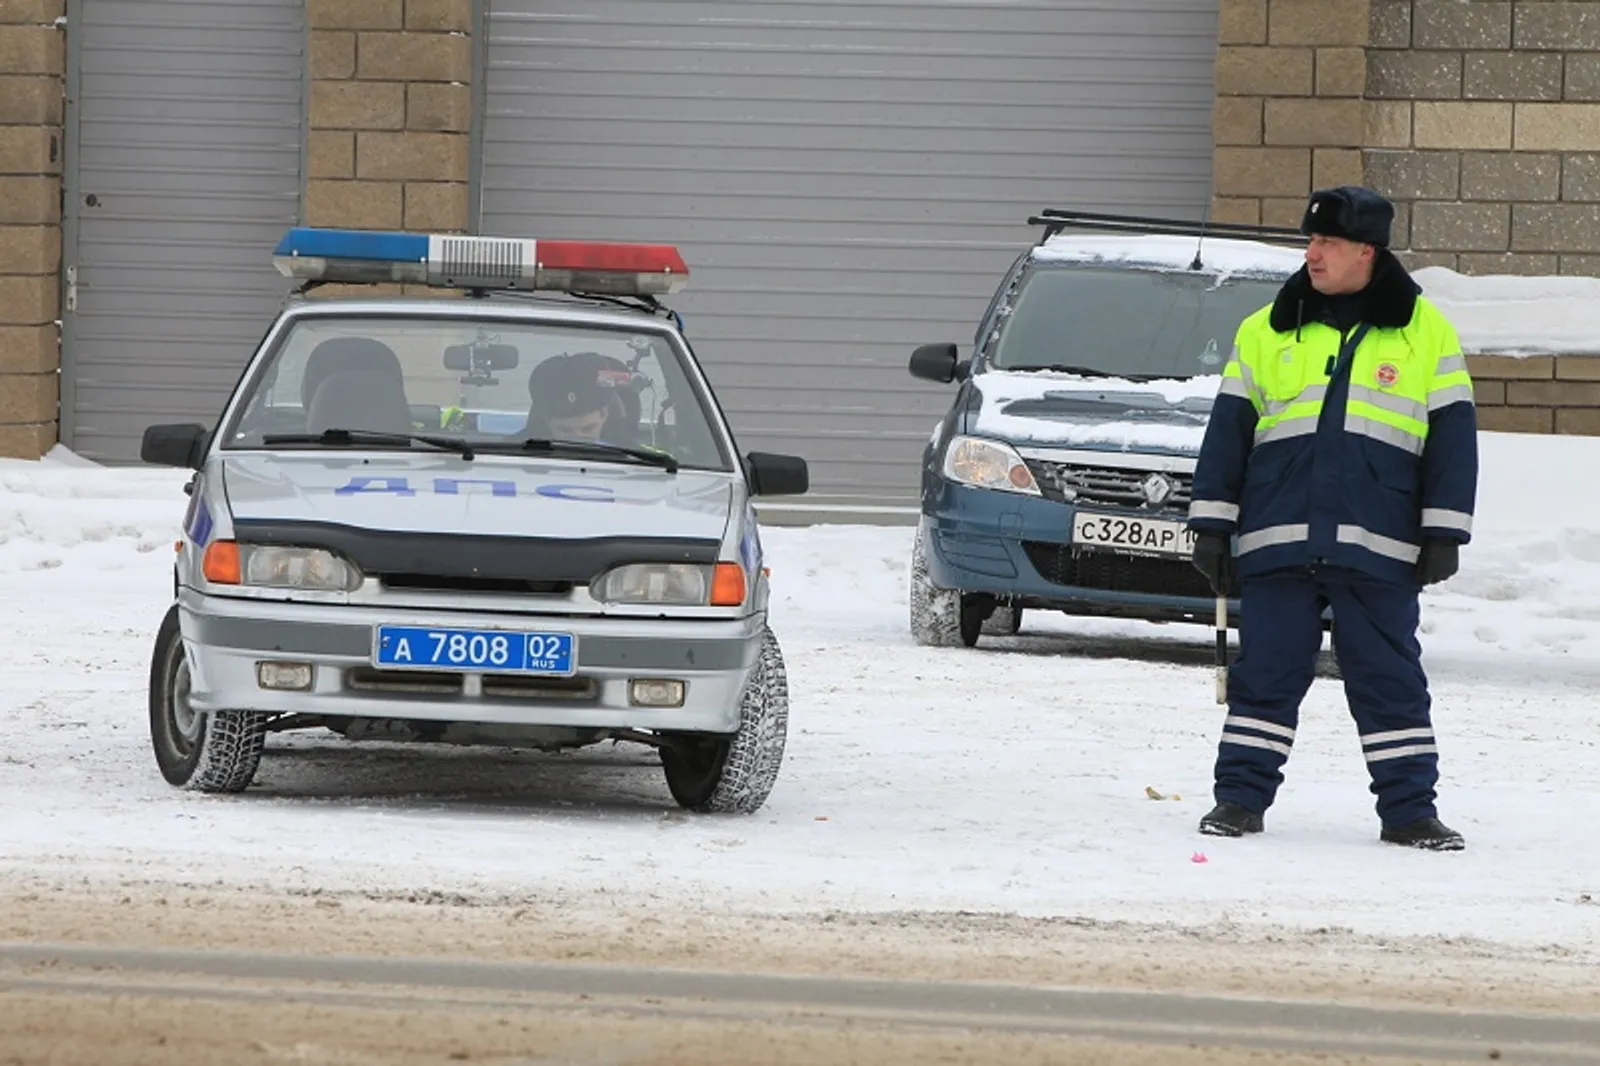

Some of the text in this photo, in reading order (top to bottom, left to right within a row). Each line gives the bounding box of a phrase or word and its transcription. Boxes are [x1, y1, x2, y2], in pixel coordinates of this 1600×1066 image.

[333, 476, 616, 502] ДПС
[428, 633, 509, 664] 7808
[529, 636, 561, 659] 02
[532, 660, 556, 669] RUS
